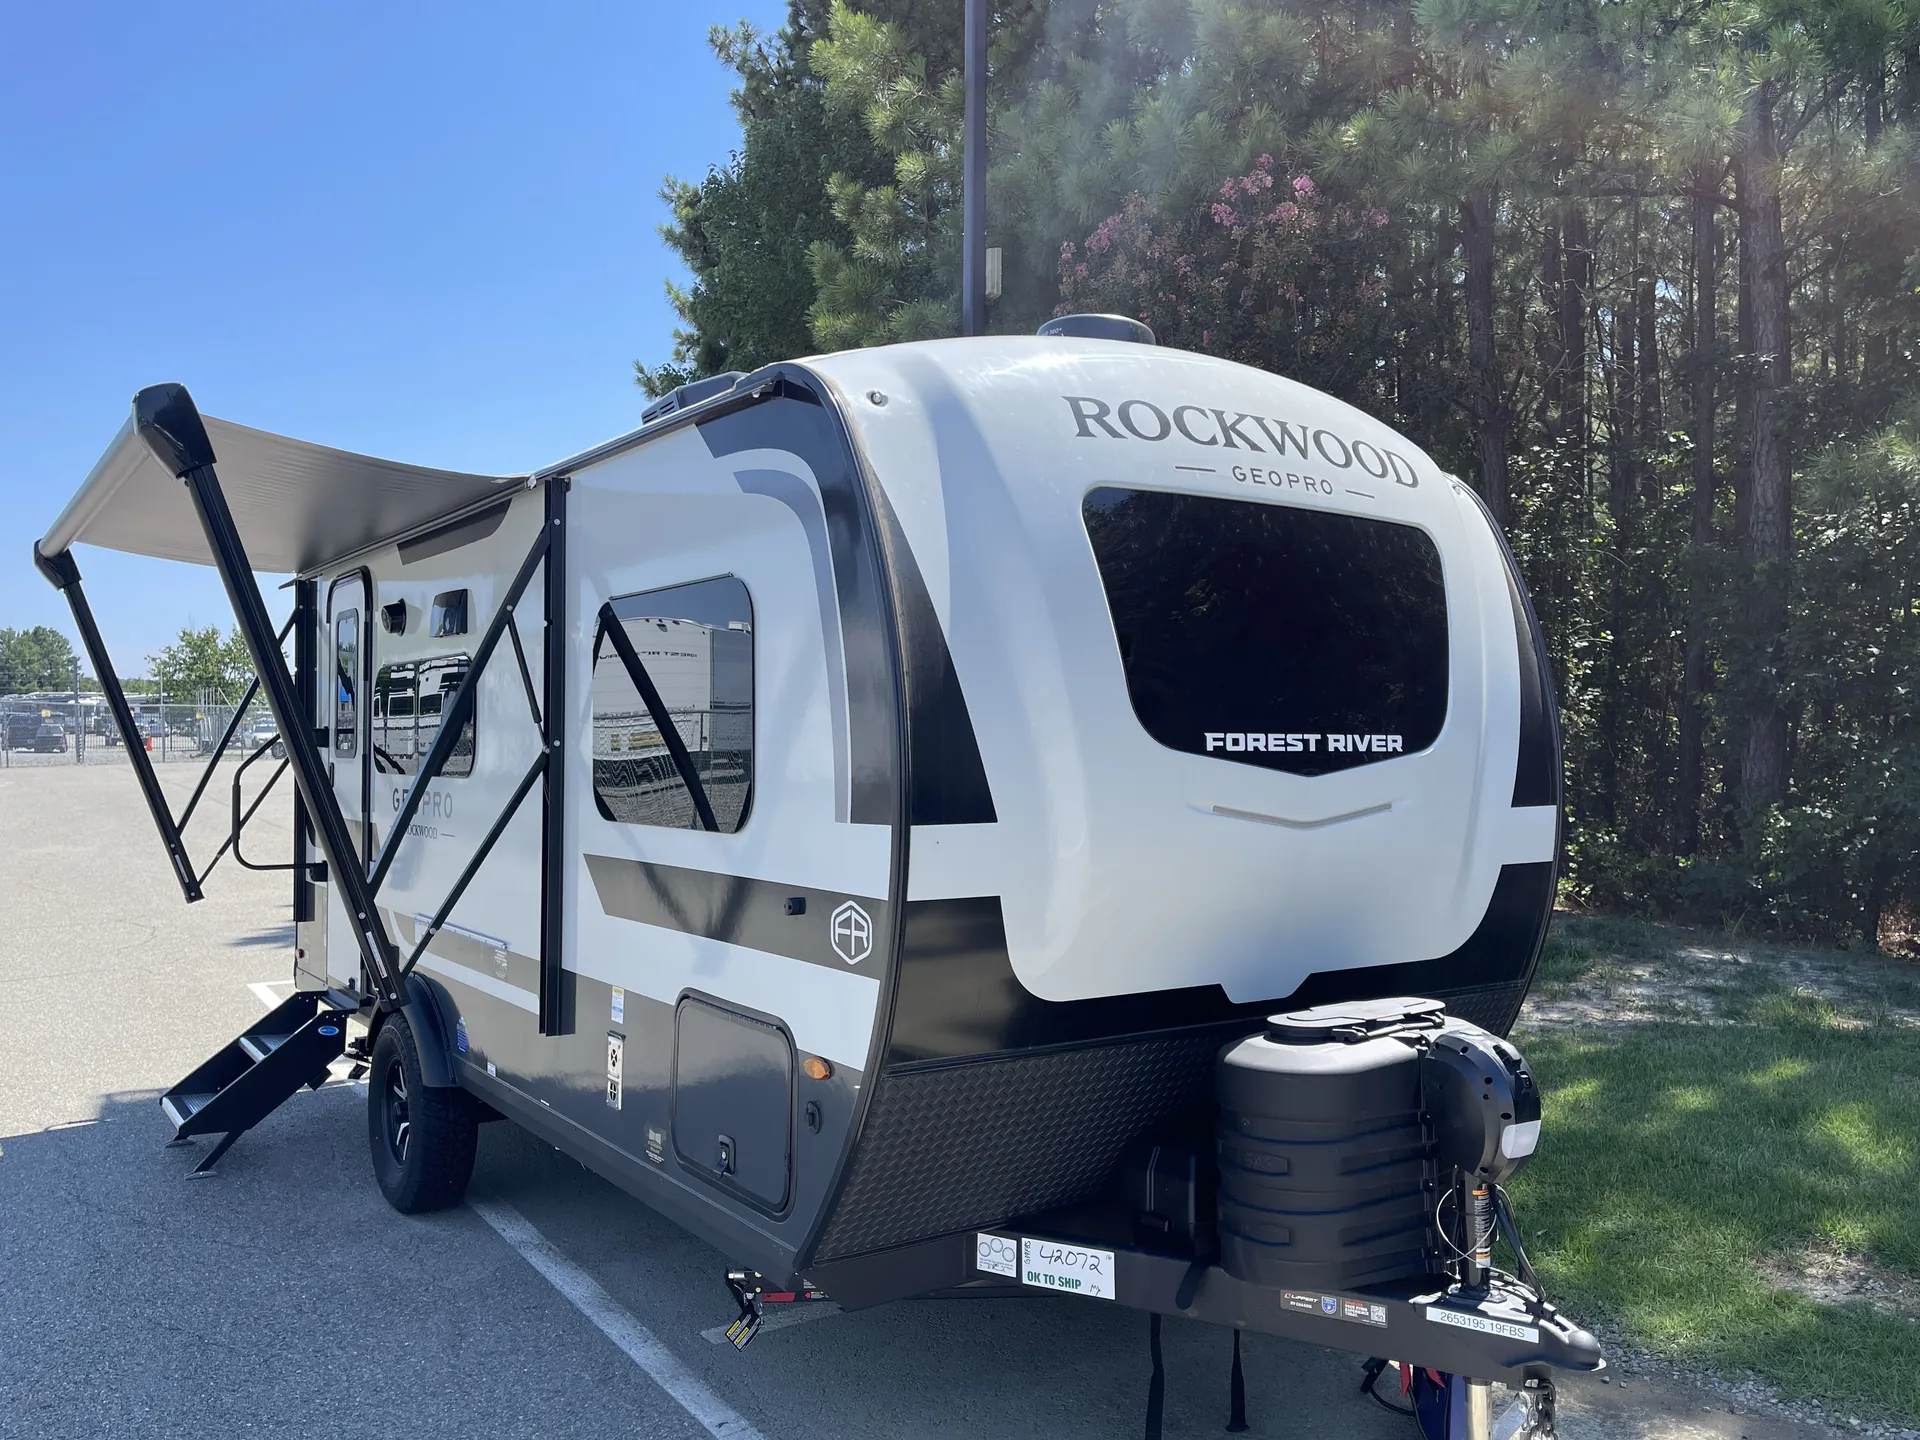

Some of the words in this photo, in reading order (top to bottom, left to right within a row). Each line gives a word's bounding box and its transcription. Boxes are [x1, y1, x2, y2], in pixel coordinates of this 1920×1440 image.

[1061, 395, 1420, 489] ROCKWOOD
[1231, 465, 1334, 496] GEOPRO
[1204, 732, 1322, 752] FOREST
[1327, 734, 1404, 752] RIVER
[392, 787, 453, 820] GPRO
[407, 823, 438, 840] OCKWOOD
[1039, 1245, 1104, 1276] 42072
[1027, 1271, 1041, 1284] OK
[1043, 1274, 1056, 1286] TO
[1058, 1276, 1082, 1290] SHIP
[1440, 1311, 1486, 1330] 2653195
[1489, 1322, 1526, 1339] 19FBS
